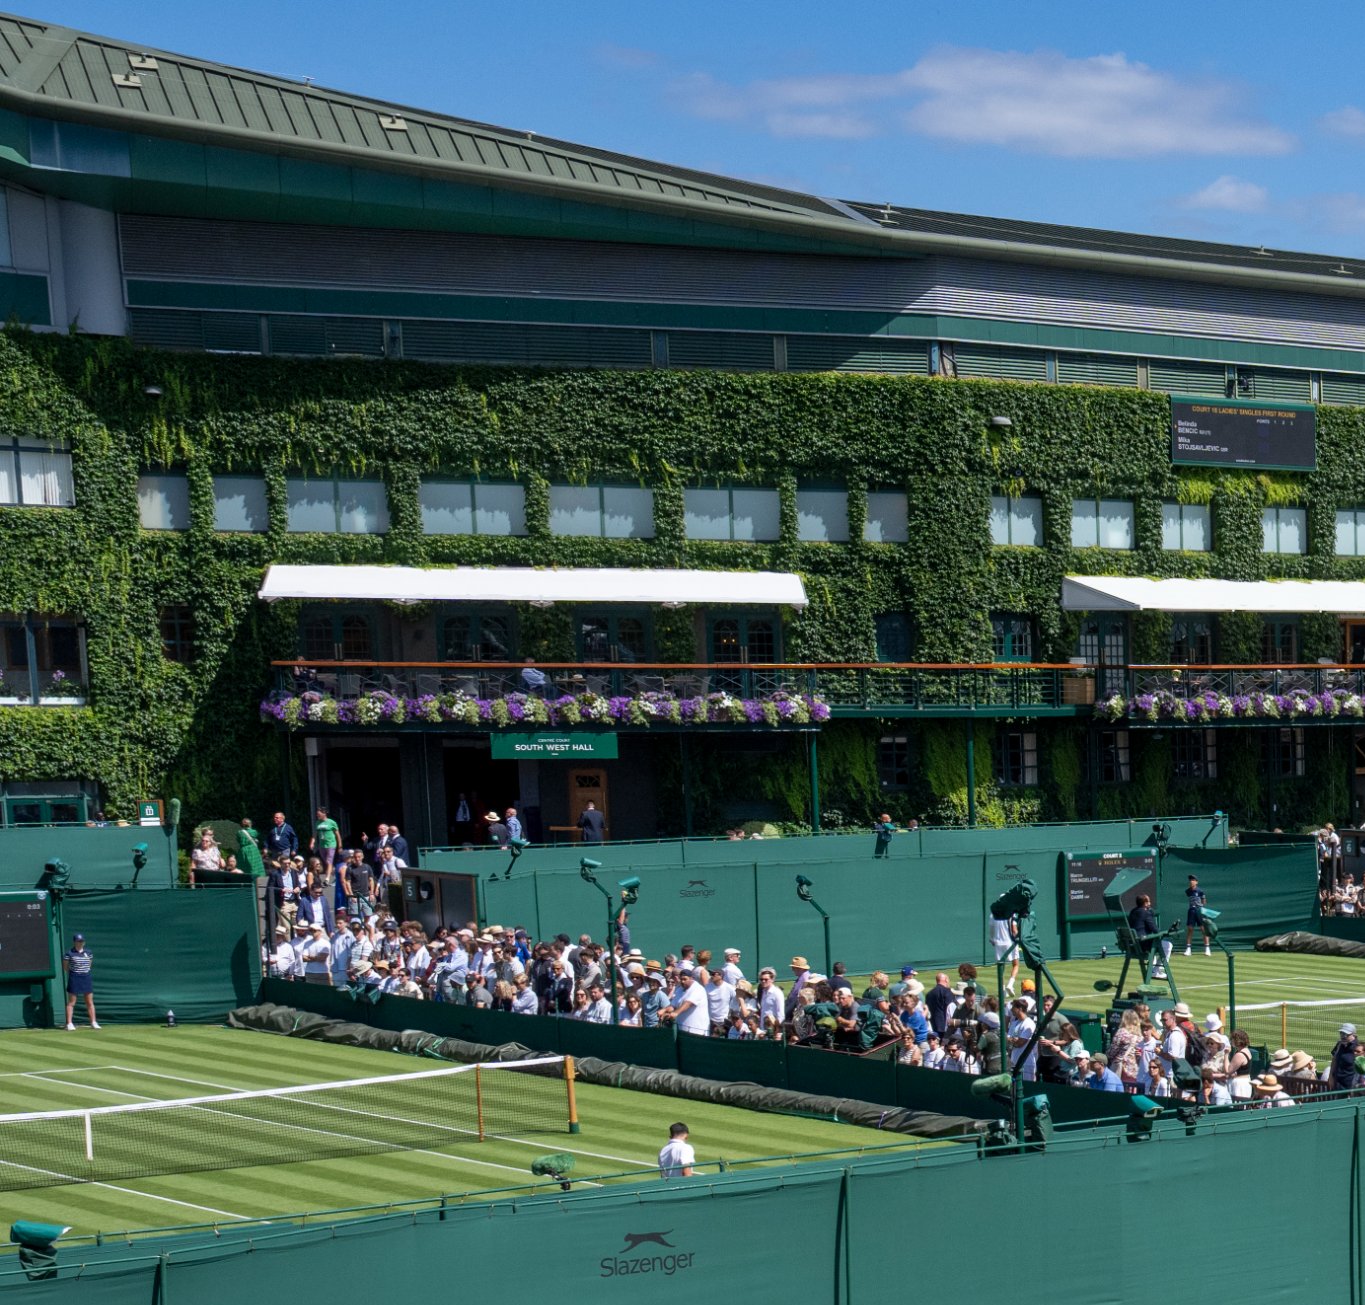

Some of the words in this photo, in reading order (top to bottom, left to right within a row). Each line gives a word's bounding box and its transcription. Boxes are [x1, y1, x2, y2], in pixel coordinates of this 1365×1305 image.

[408, 886, 413, 896] 5
[679, 889, 715, 899] Slazenger
[600, 1252, 695, 1277] Slazenger
